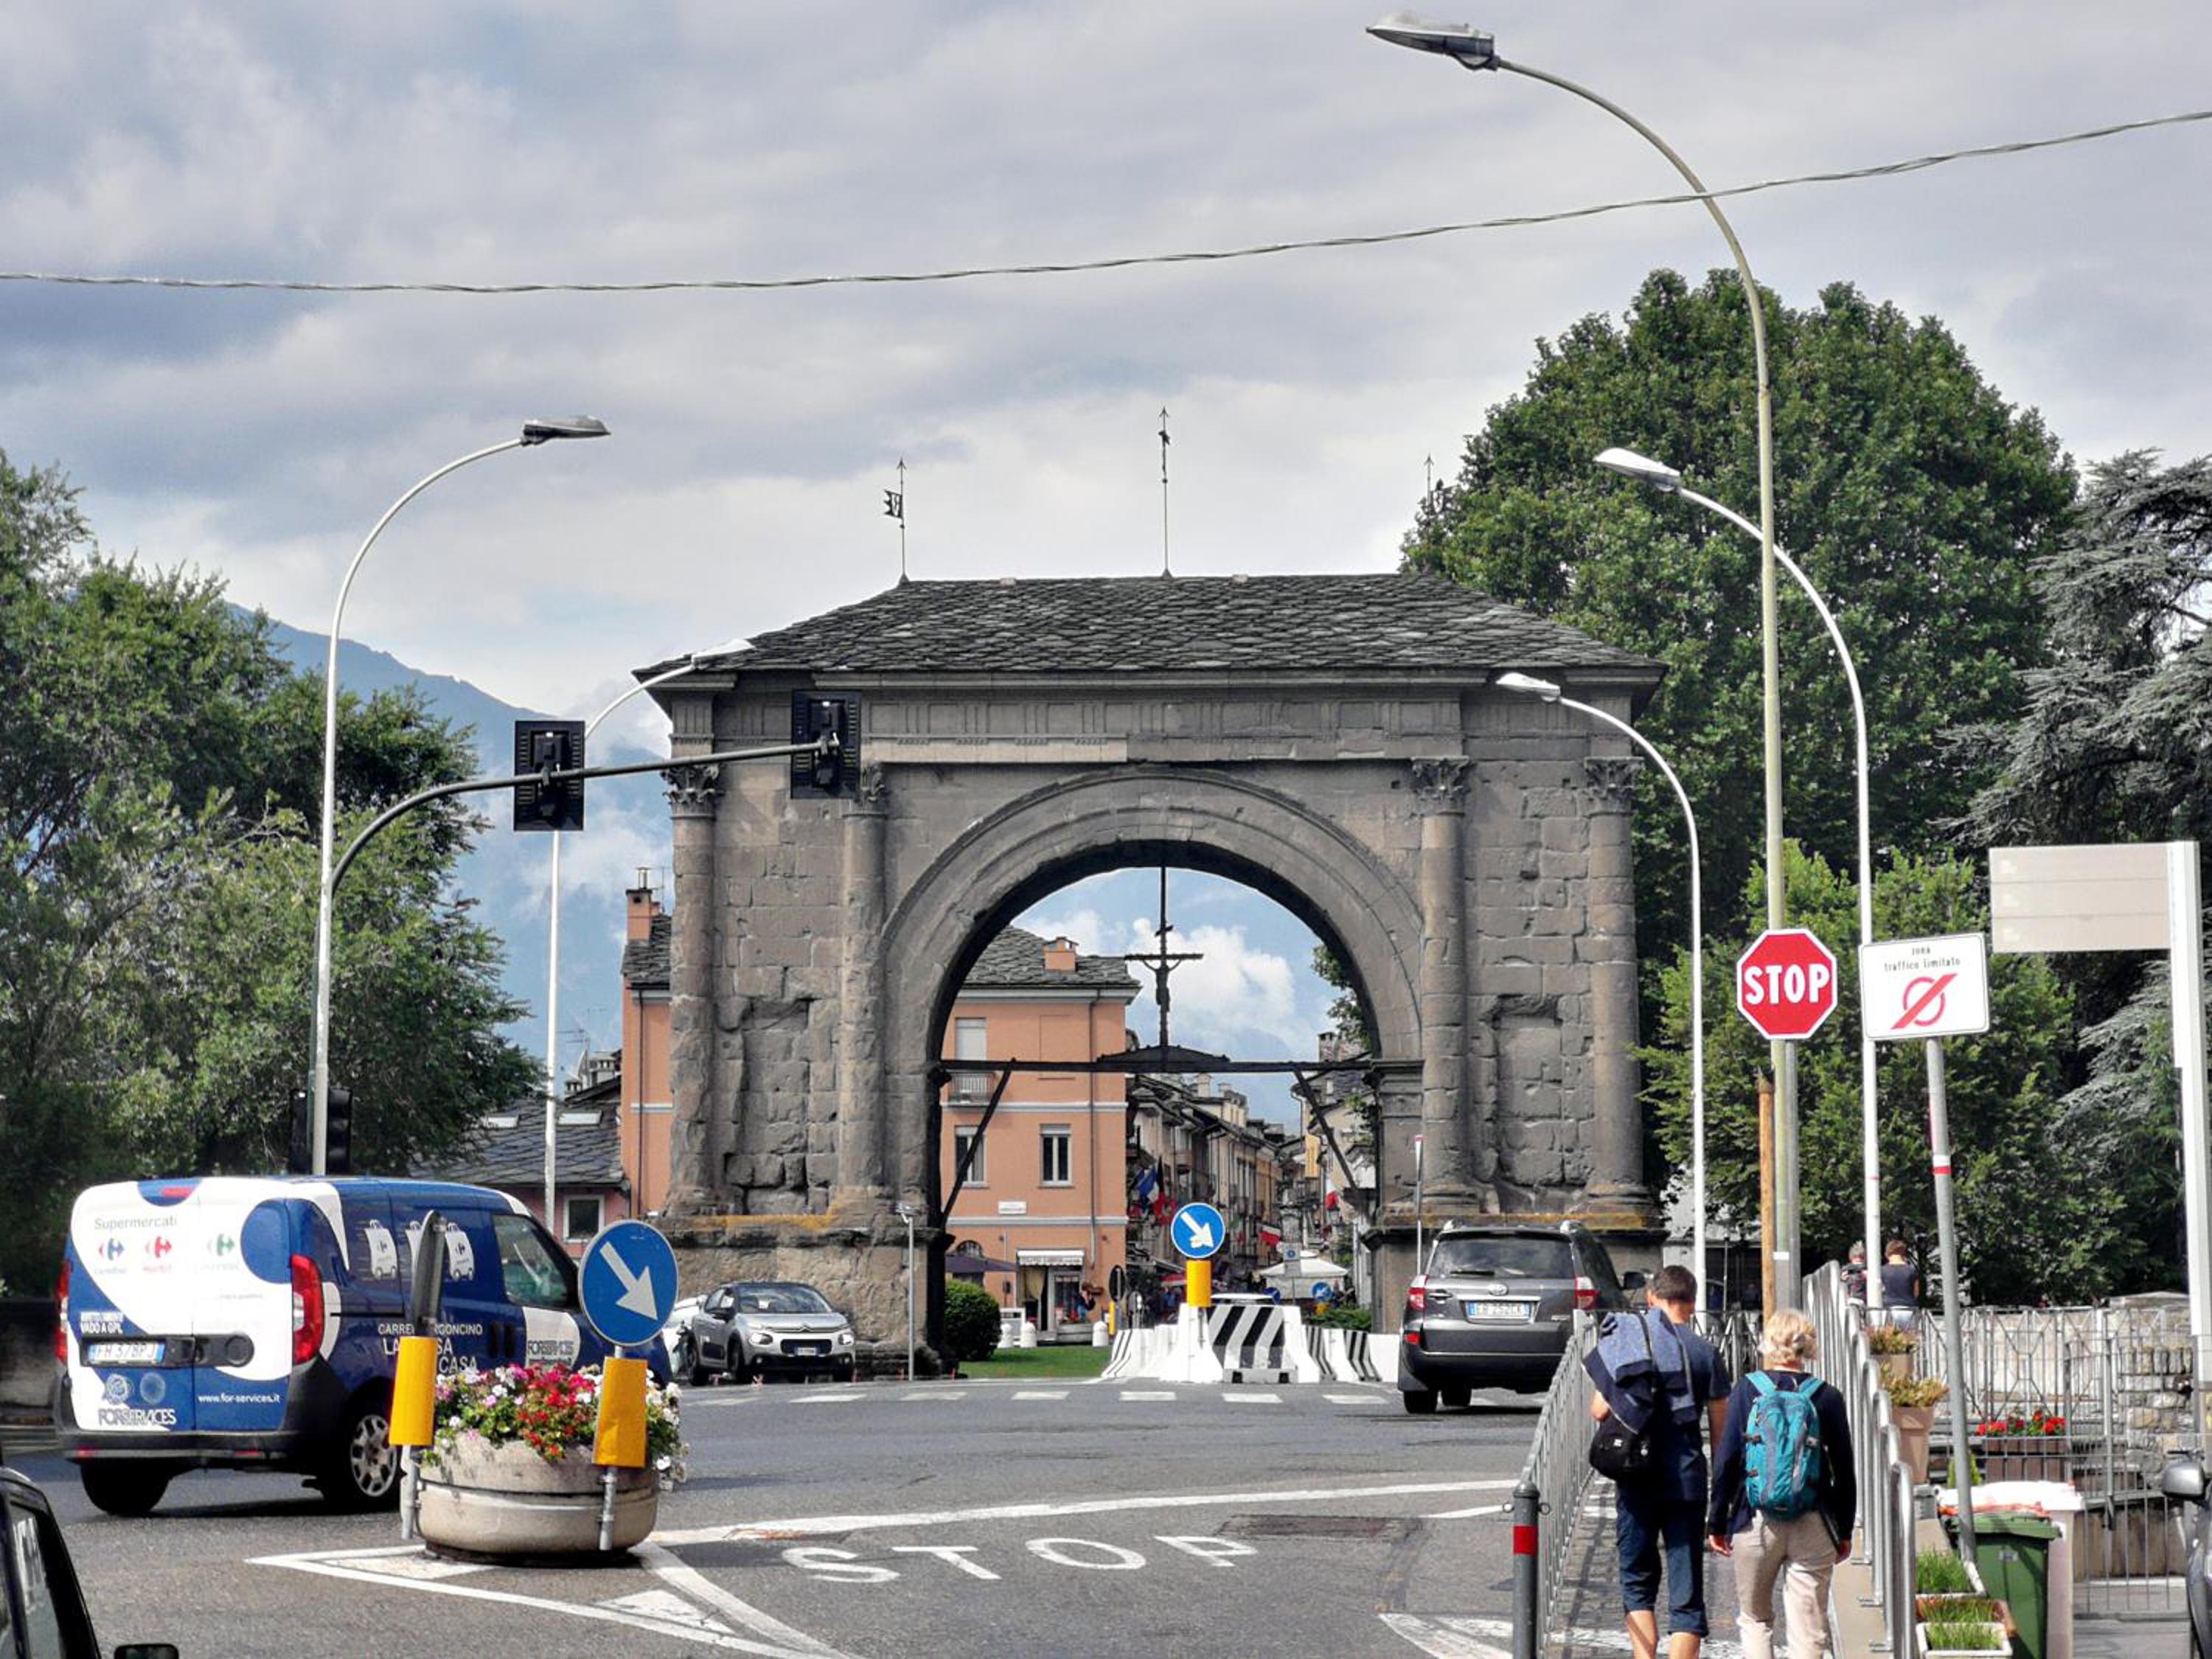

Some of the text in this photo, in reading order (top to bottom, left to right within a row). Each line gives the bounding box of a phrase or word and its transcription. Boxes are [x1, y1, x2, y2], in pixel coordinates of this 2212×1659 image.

[1884, 957, 1961, 971] traffico limitato
[1745, 964, 1830, 1005] STOP
[94, 1215, 178, 1230] Supermercati
[439, 1356, 478, 1374] CASA
[198, 1392, 281, 1404] www.for-services.it
[98, 1408, 176, 1425] FORSERVICES
[782, 1535, 1258, 1584] STOP
